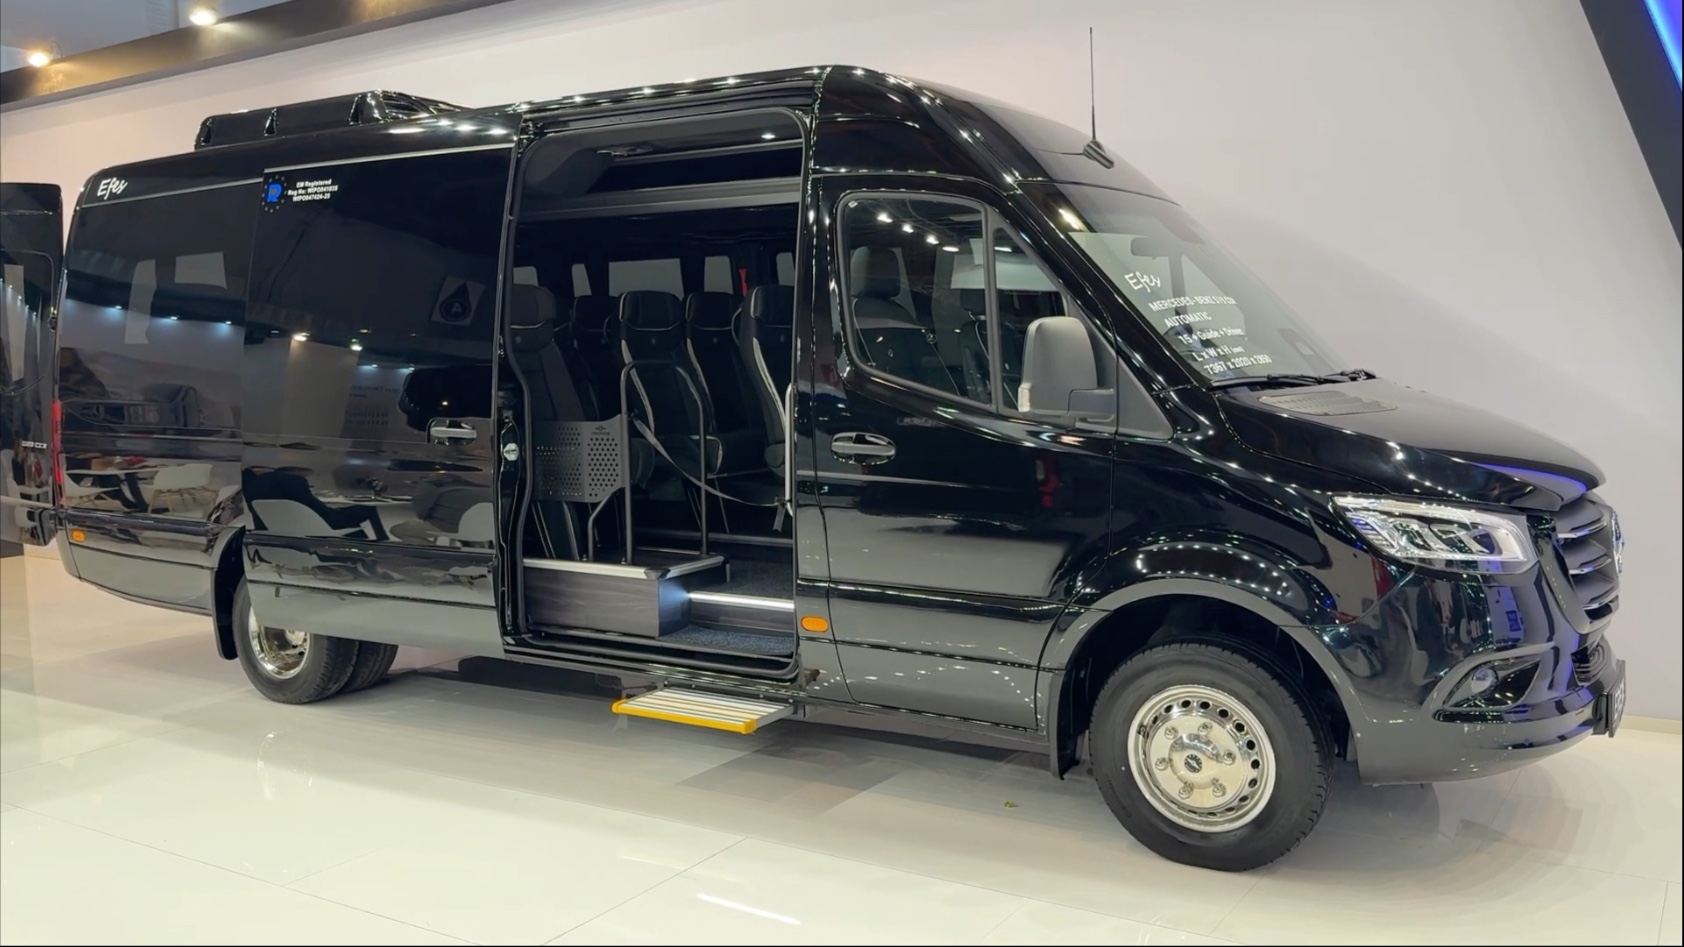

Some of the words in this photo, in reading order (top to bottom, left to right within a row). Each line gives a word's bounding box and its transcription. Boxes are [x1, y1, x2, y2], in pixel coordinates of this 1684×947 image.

[97, 177, 128, 200] Efes
[305, 179, 332, 187] Registered
[1124, 271, 1161, 293] Efes
[1163, 312, 1212, 328] AUTOMATIC
[1178, 333, 1193, 345] 15
[1196, 328, 1221, 340] Guide
[1192, 352, 1203, 361] L
[1207, 347, 1218, 358] W
[1221, 344, 1232, 354] H
[1203, 361, 1228, 375] 7367
[1231, 357, 1252, 368] 2020
